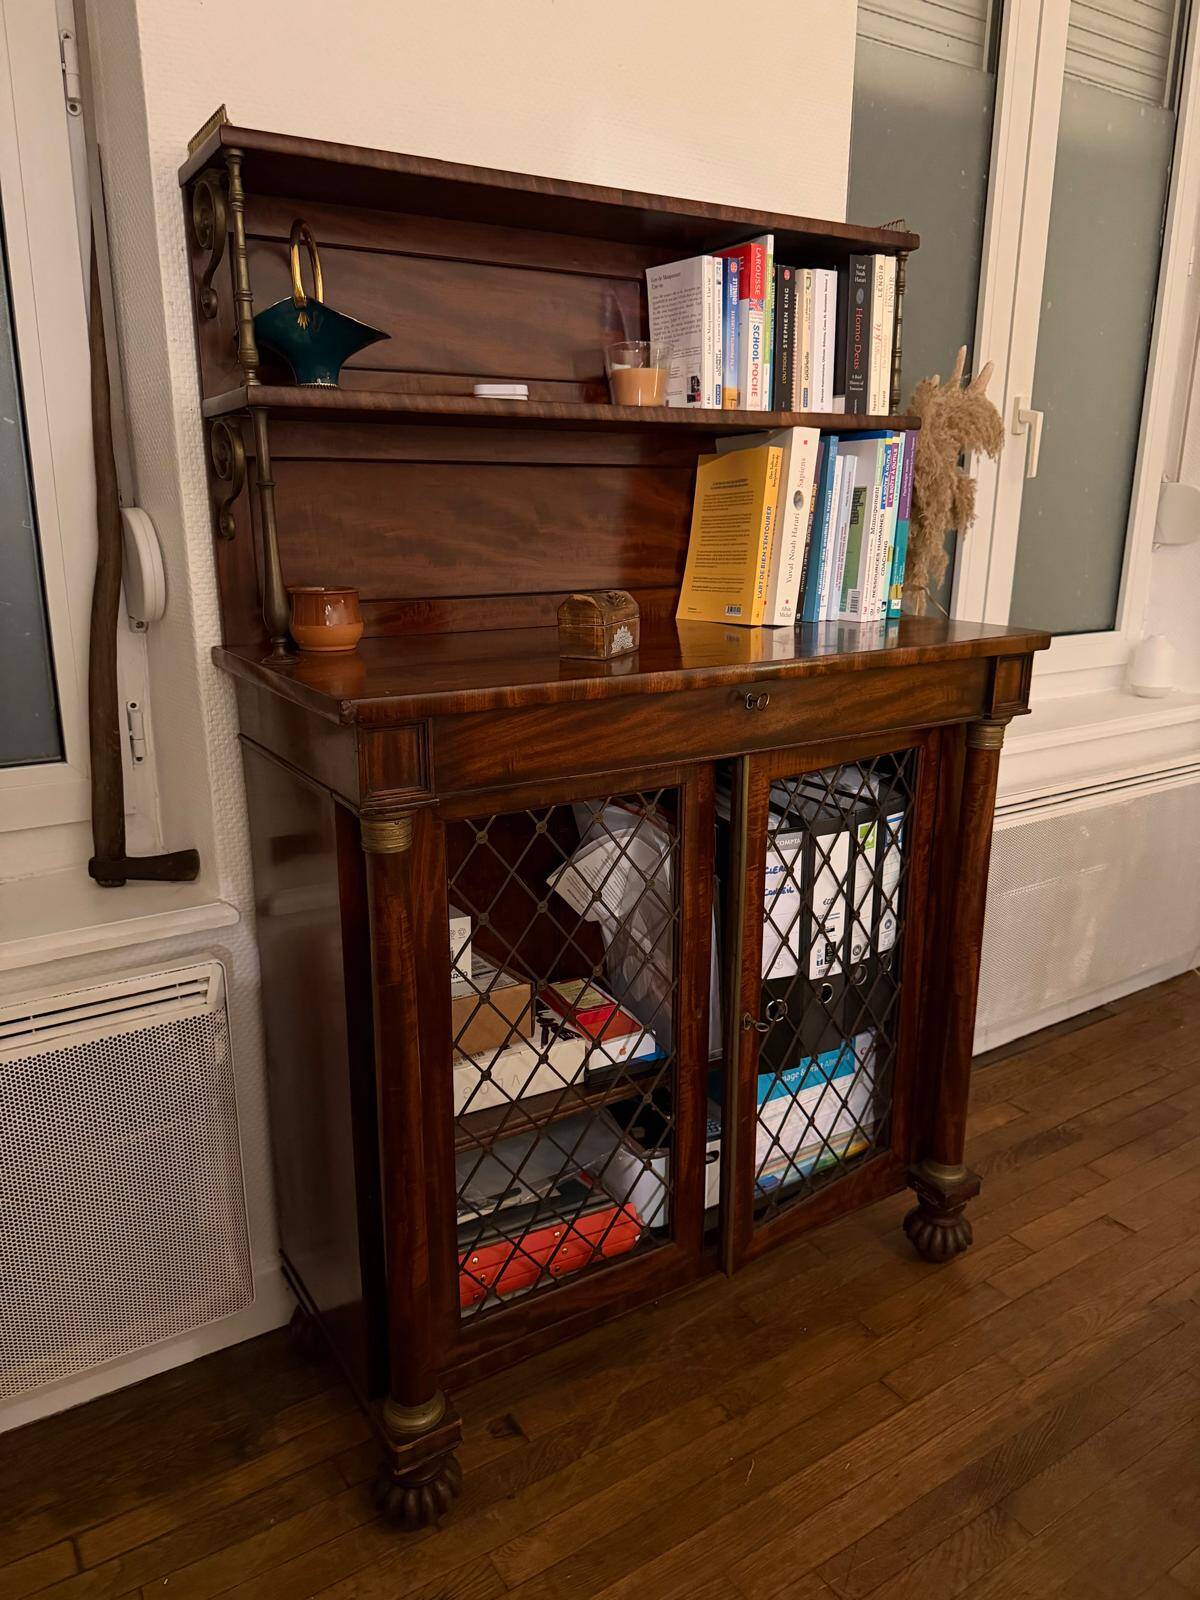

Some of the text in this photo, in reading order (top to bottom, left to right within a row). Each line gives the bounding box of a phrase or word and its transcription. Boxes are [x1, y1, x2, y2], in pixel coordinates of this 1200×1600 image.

[754, 247, 762, 295] LAROUSSE
[887, 276, 895, 313] LENOIR
[752, 324, 760, 362] SCHOOL
[853, 307, 863, 370] Homo Deus
[796, 457, 808, 489] Sapiens
[870, 486, 880, 535] Management
[759, 570, 765, 580] DE
[762, 505, 772, 551] S'ENTOURER
[785, 512, 800, 584] Yuval Noah Harari
[881, 540, 889, 576] COACHING
[872, 552, 880, 599] RESSOURCES
